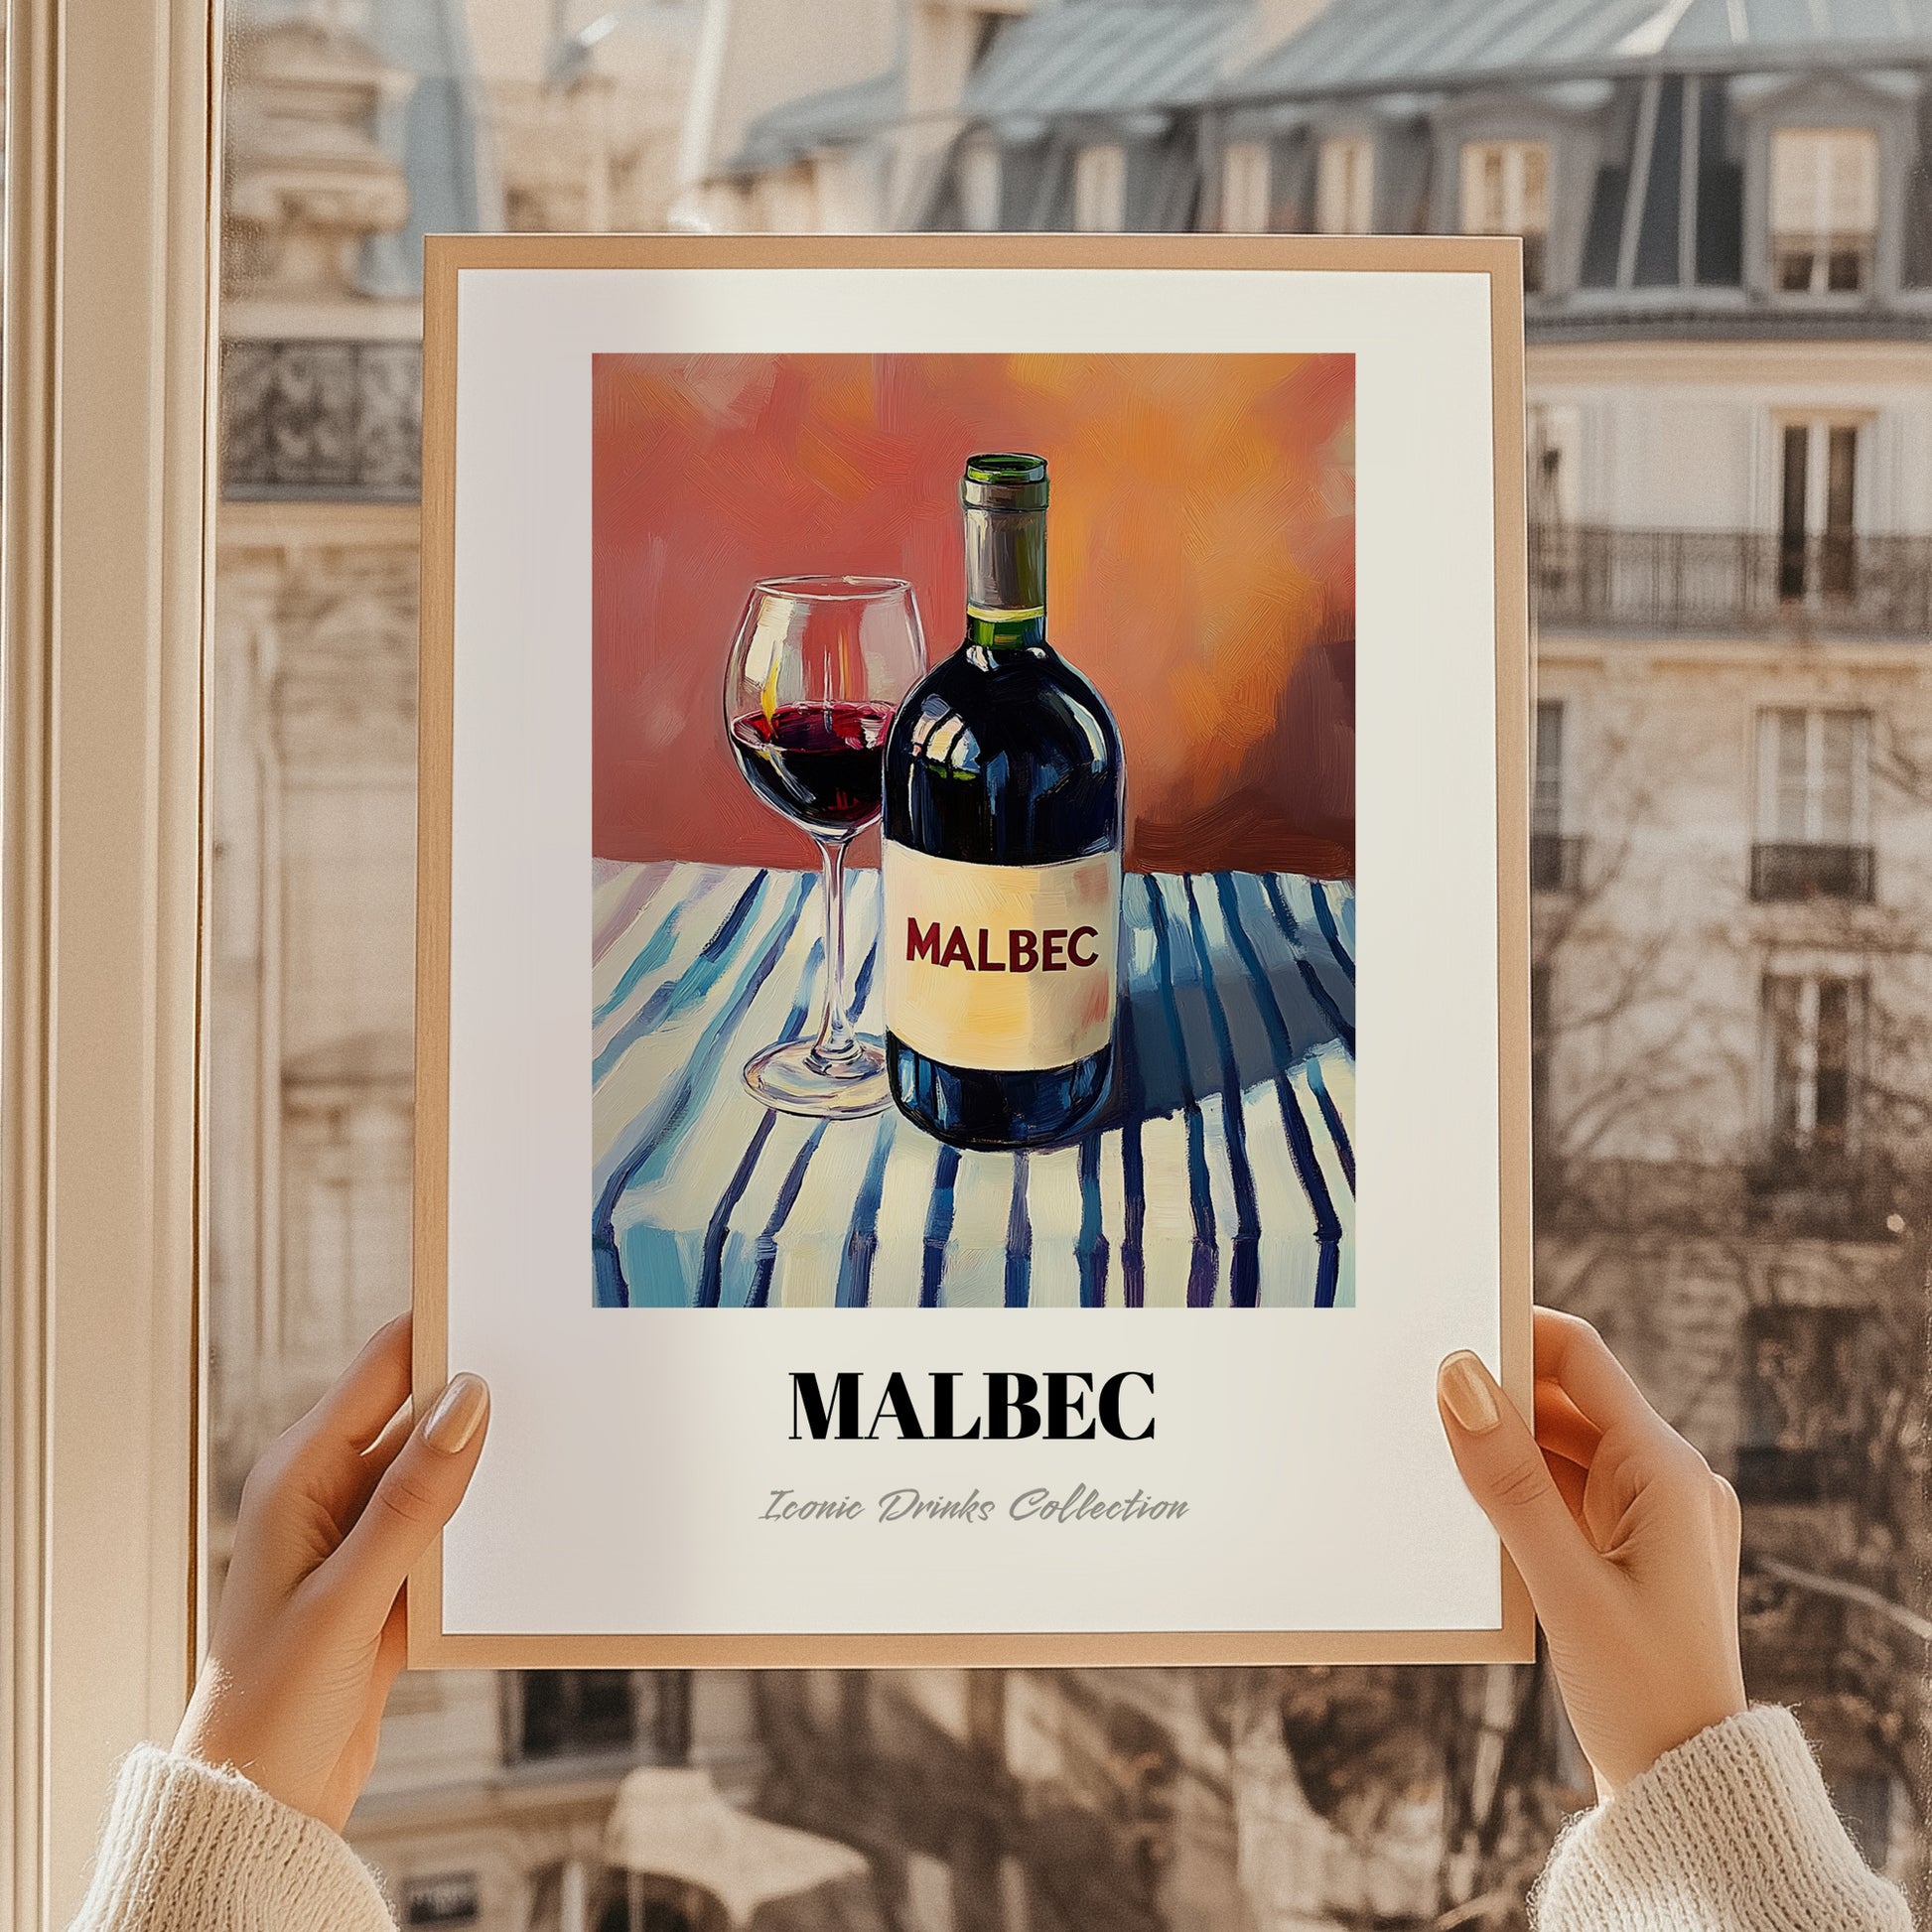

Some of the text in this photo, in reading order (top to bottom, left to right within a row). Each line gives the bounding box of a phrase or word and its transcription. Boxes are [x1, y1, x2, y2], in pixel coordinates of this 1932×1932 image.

[906, 916, 1099, 973] MALBEC
[788, 1371, 1156, 1441] MALBEC
[759, 1482, 1189, 1523] Iconic Drinks Collection
